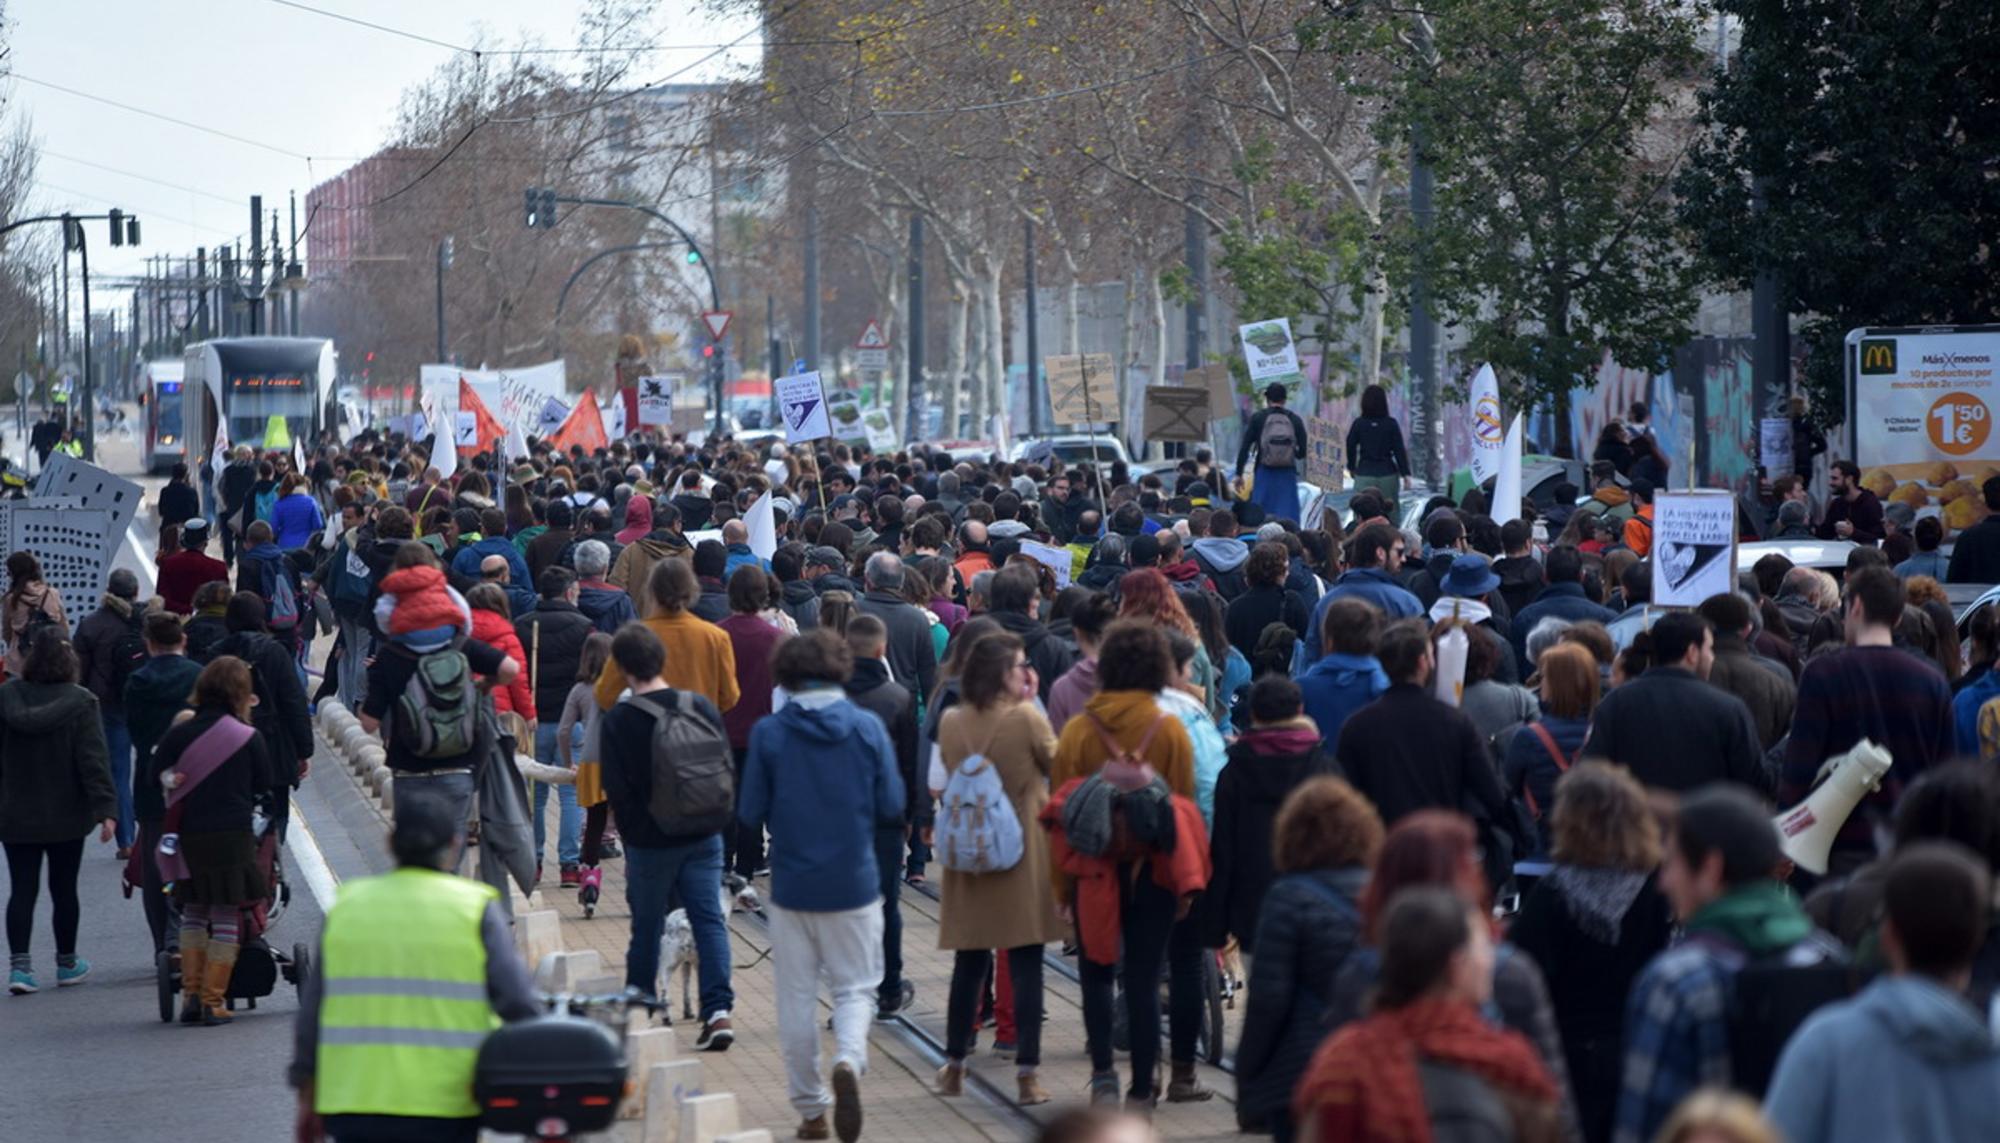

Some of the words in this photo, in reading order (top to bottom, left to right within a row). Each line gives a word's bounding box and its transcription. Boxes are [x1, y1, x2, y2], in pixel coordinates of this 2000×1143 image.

[1922, 369, 1973, 379] productos
[1663, 509, 1675, 518] LA
[1662, 520, 1699, 530] NOSTRA
[1708, 522, 1719, 530] LA
